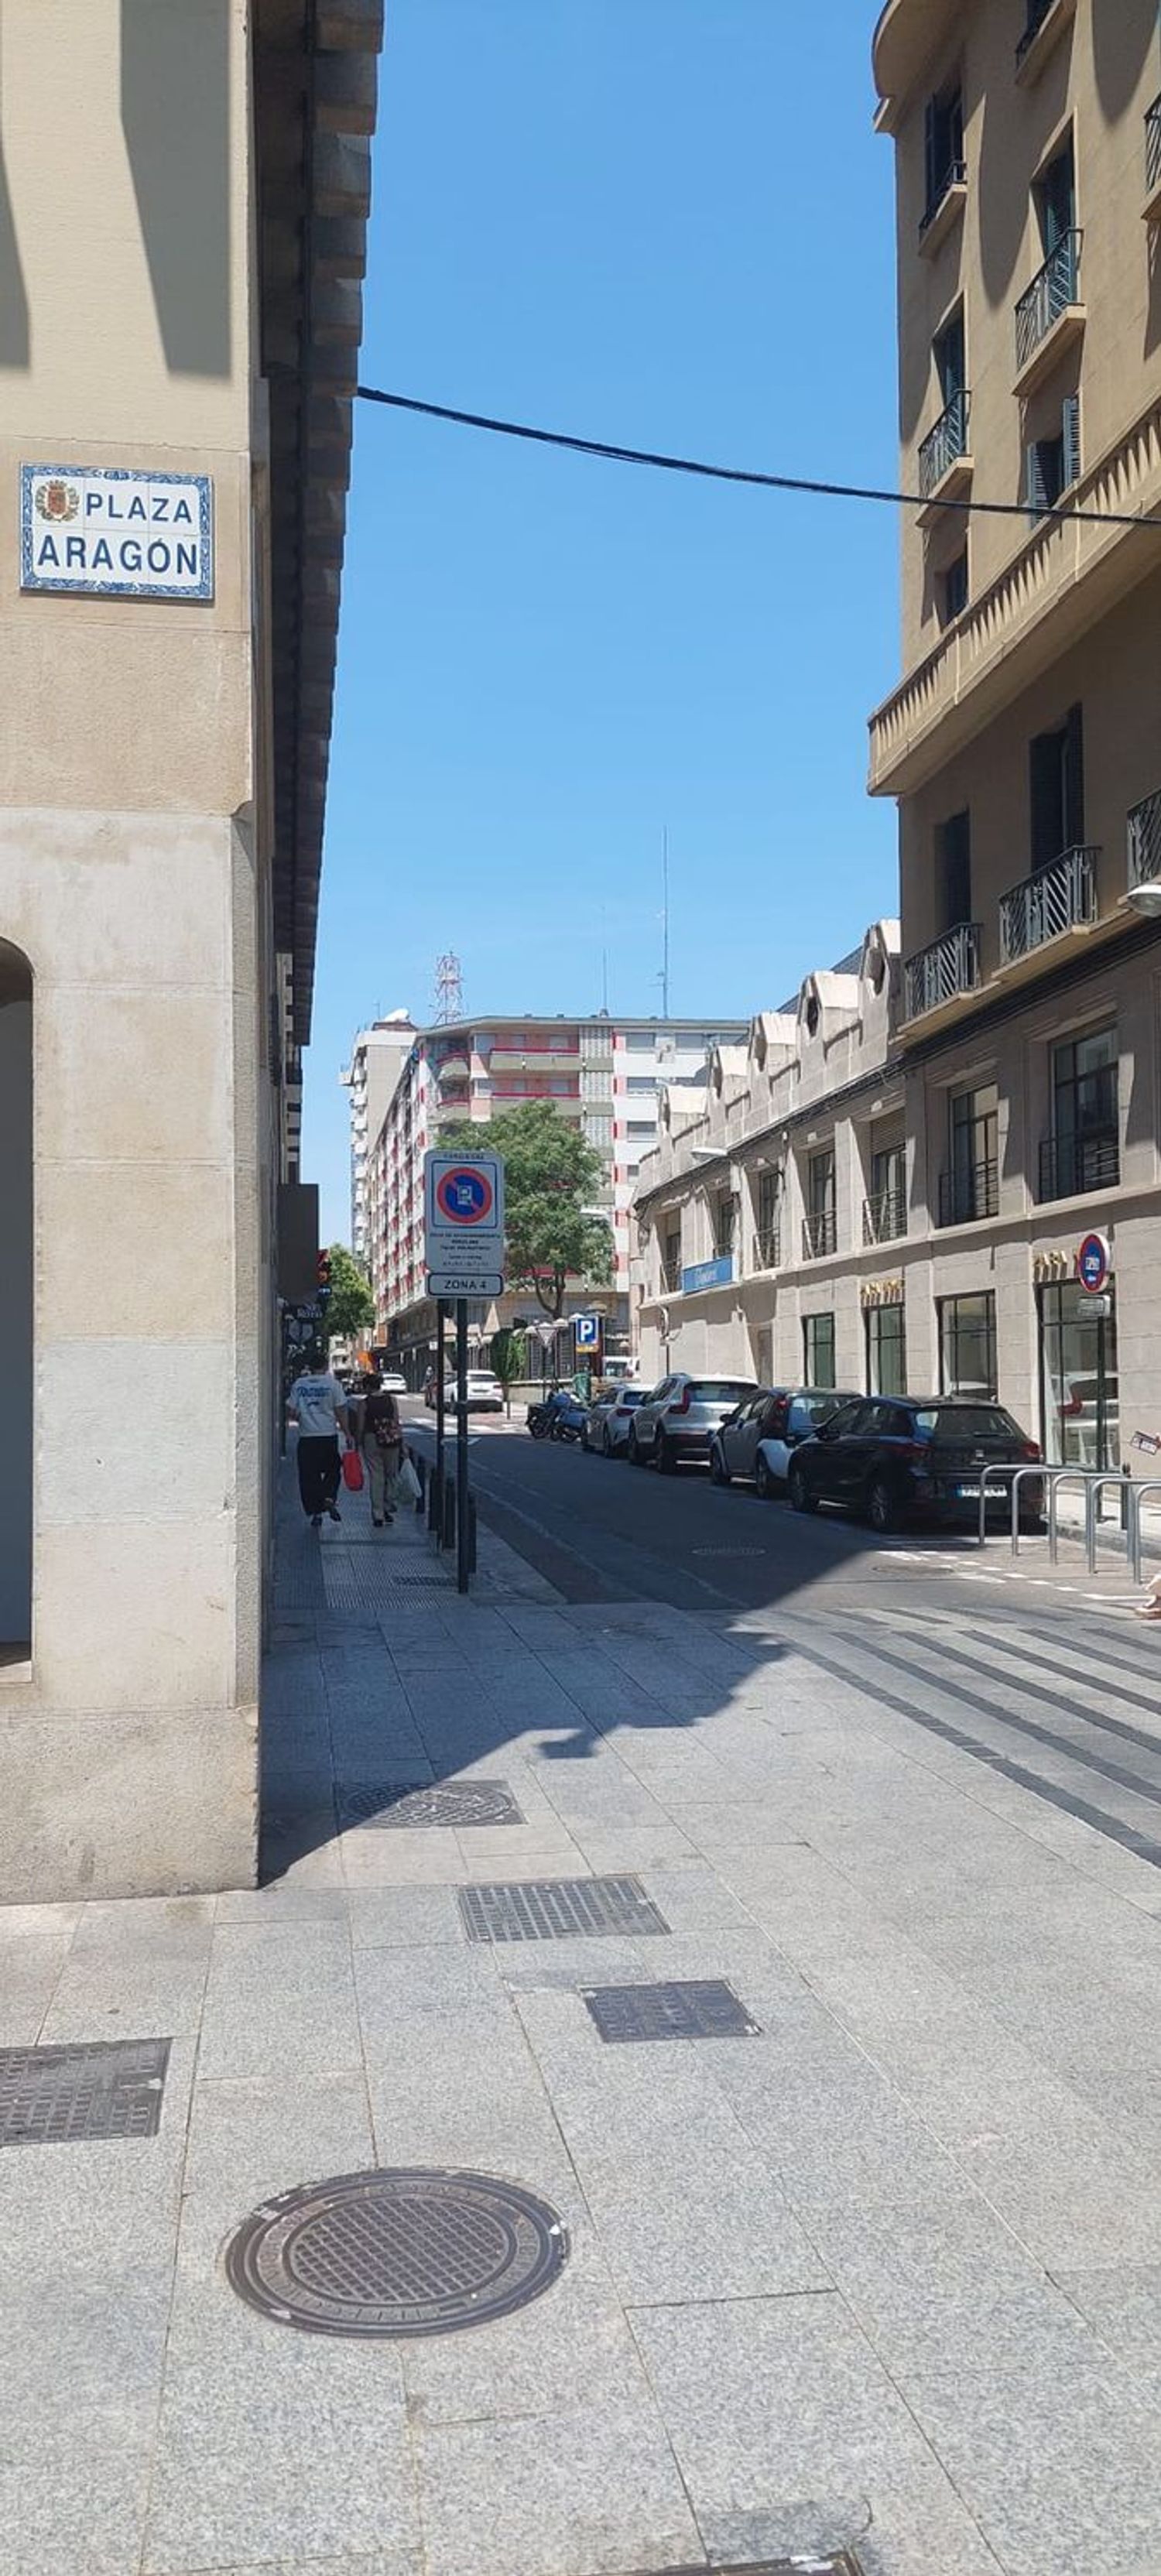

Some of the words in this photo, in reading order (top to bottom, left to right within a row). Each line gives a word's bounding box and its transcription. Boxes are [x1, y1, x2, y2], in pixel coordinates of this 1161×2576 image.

[86, 493, 192, 522] PLAZA
[38, 535, 197, 574] ARAGÓN
[444, 1280, 477, 1290] ZONA
[580, 1321, 594, 1341] P
